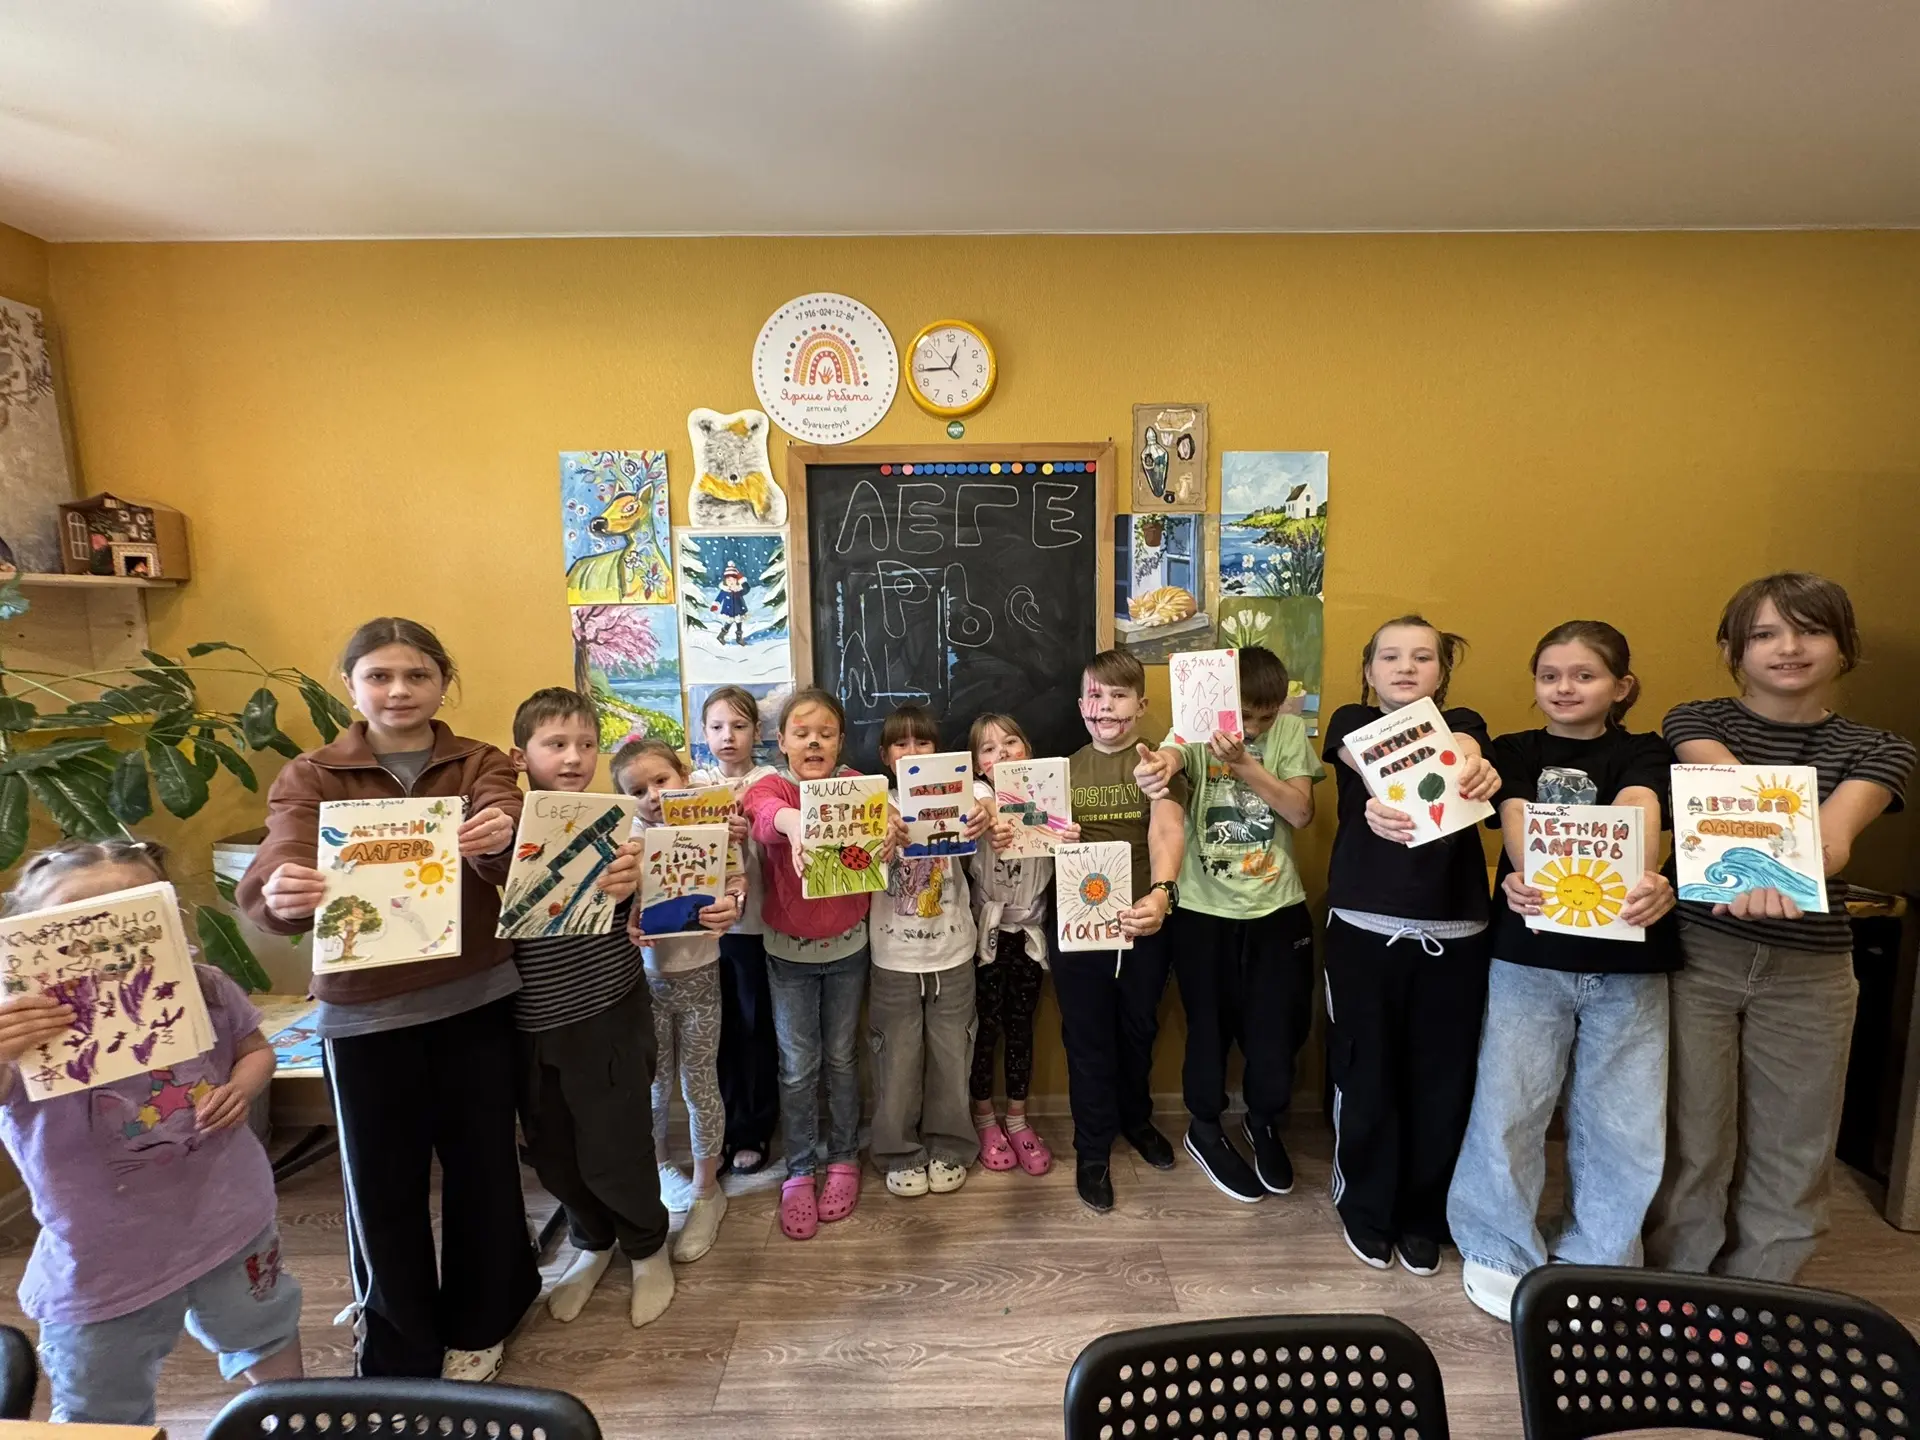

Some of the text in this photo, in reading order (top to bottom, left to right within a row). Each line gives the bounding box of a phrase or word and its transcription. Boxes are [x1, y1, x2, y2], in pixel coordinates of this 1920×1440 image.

[932, 337, 940, 347] 11
[945, 334, 956, 343] 12
[962, 338, 967, 347] 1
[923, 350, 933, 359] 10
[971, 349, 979, 359] 2
[976, 364, 983, 373] 3
[922, 378, 930, 387] 8
[972, 379, 979, 387] 4
[780, 388, 823, 406] Яркие
[933, 389, 940, 398] 7
[961, 389, 968, 399] 5
[946, 394, 954, 403] 6
[1070, 783, 1149, 808] OSITIV
[1098, 813, 1108, 821] ON
[1109, 812, 1123, 820] THE
[1123, 810, 1142, 820] GOOD
[1528, 818, 1630, 840] ЛЕТНИЙ
[1529, 837, 1623, 860] ЛАГЕРЬ
